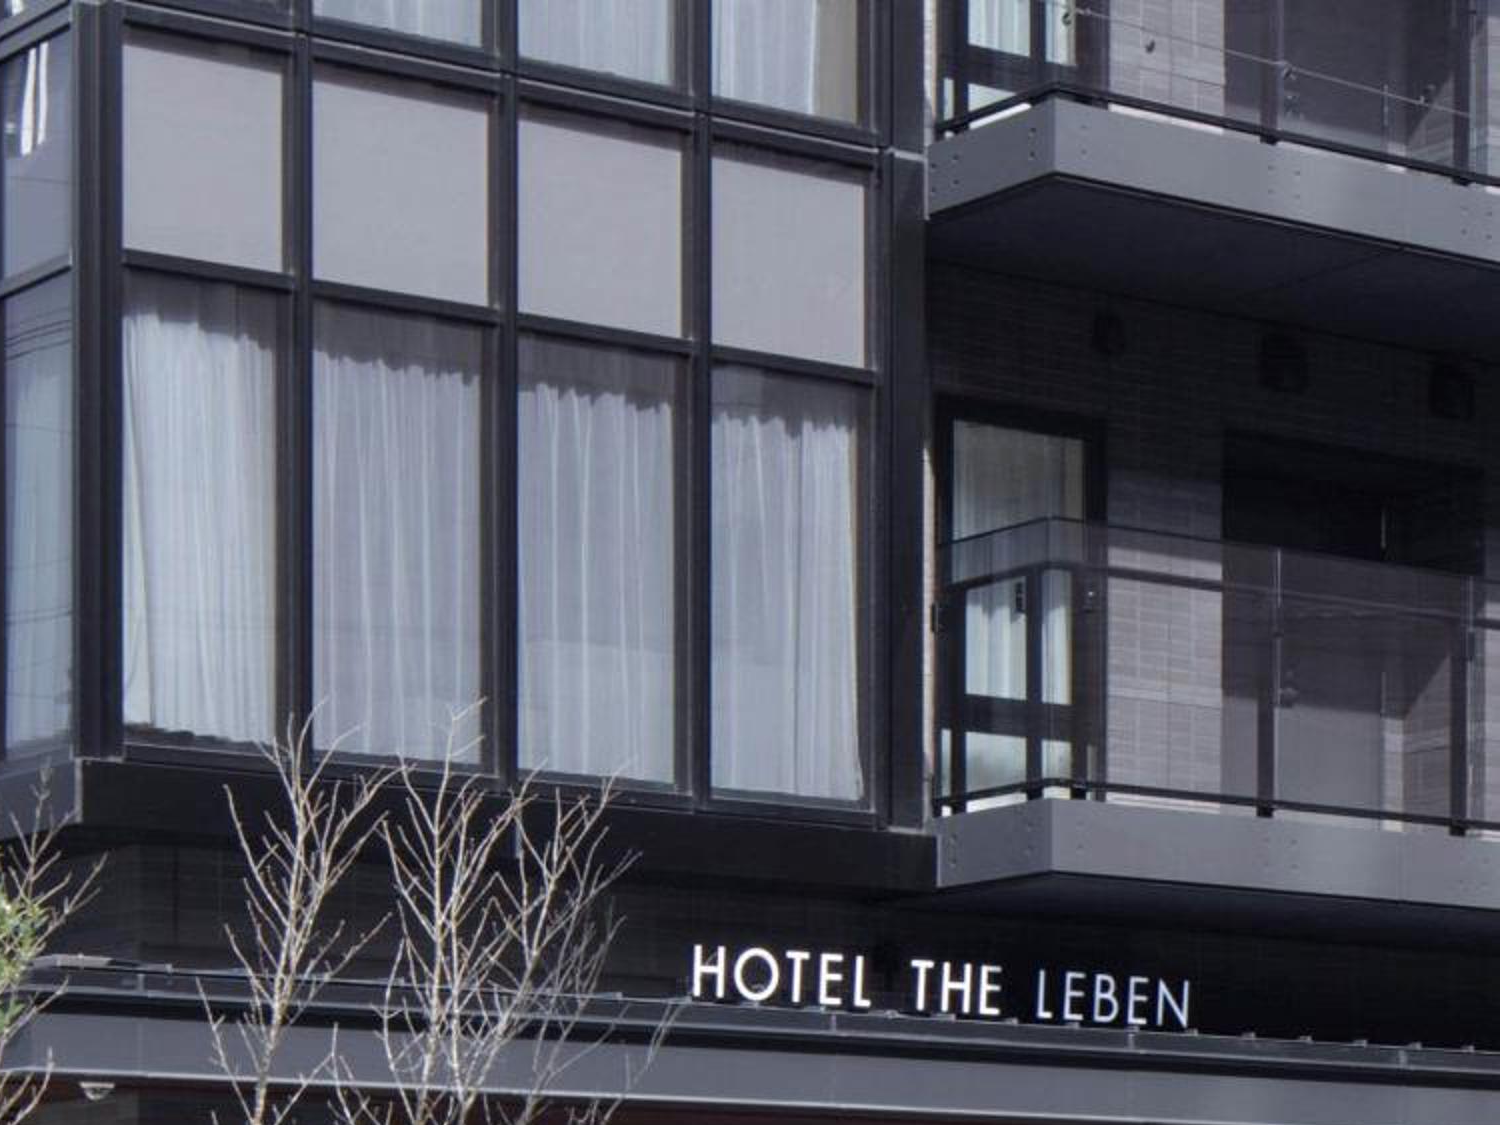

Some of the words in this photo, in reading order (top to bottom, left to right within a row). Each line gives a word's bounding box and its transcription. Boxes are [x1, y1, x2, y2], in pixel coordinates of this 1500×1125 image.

[692, 944, 872, 1009] HOTEL
[910, 959, 1002, 1016] THE
[1037, 969, 1192, 1028] LEBEN
